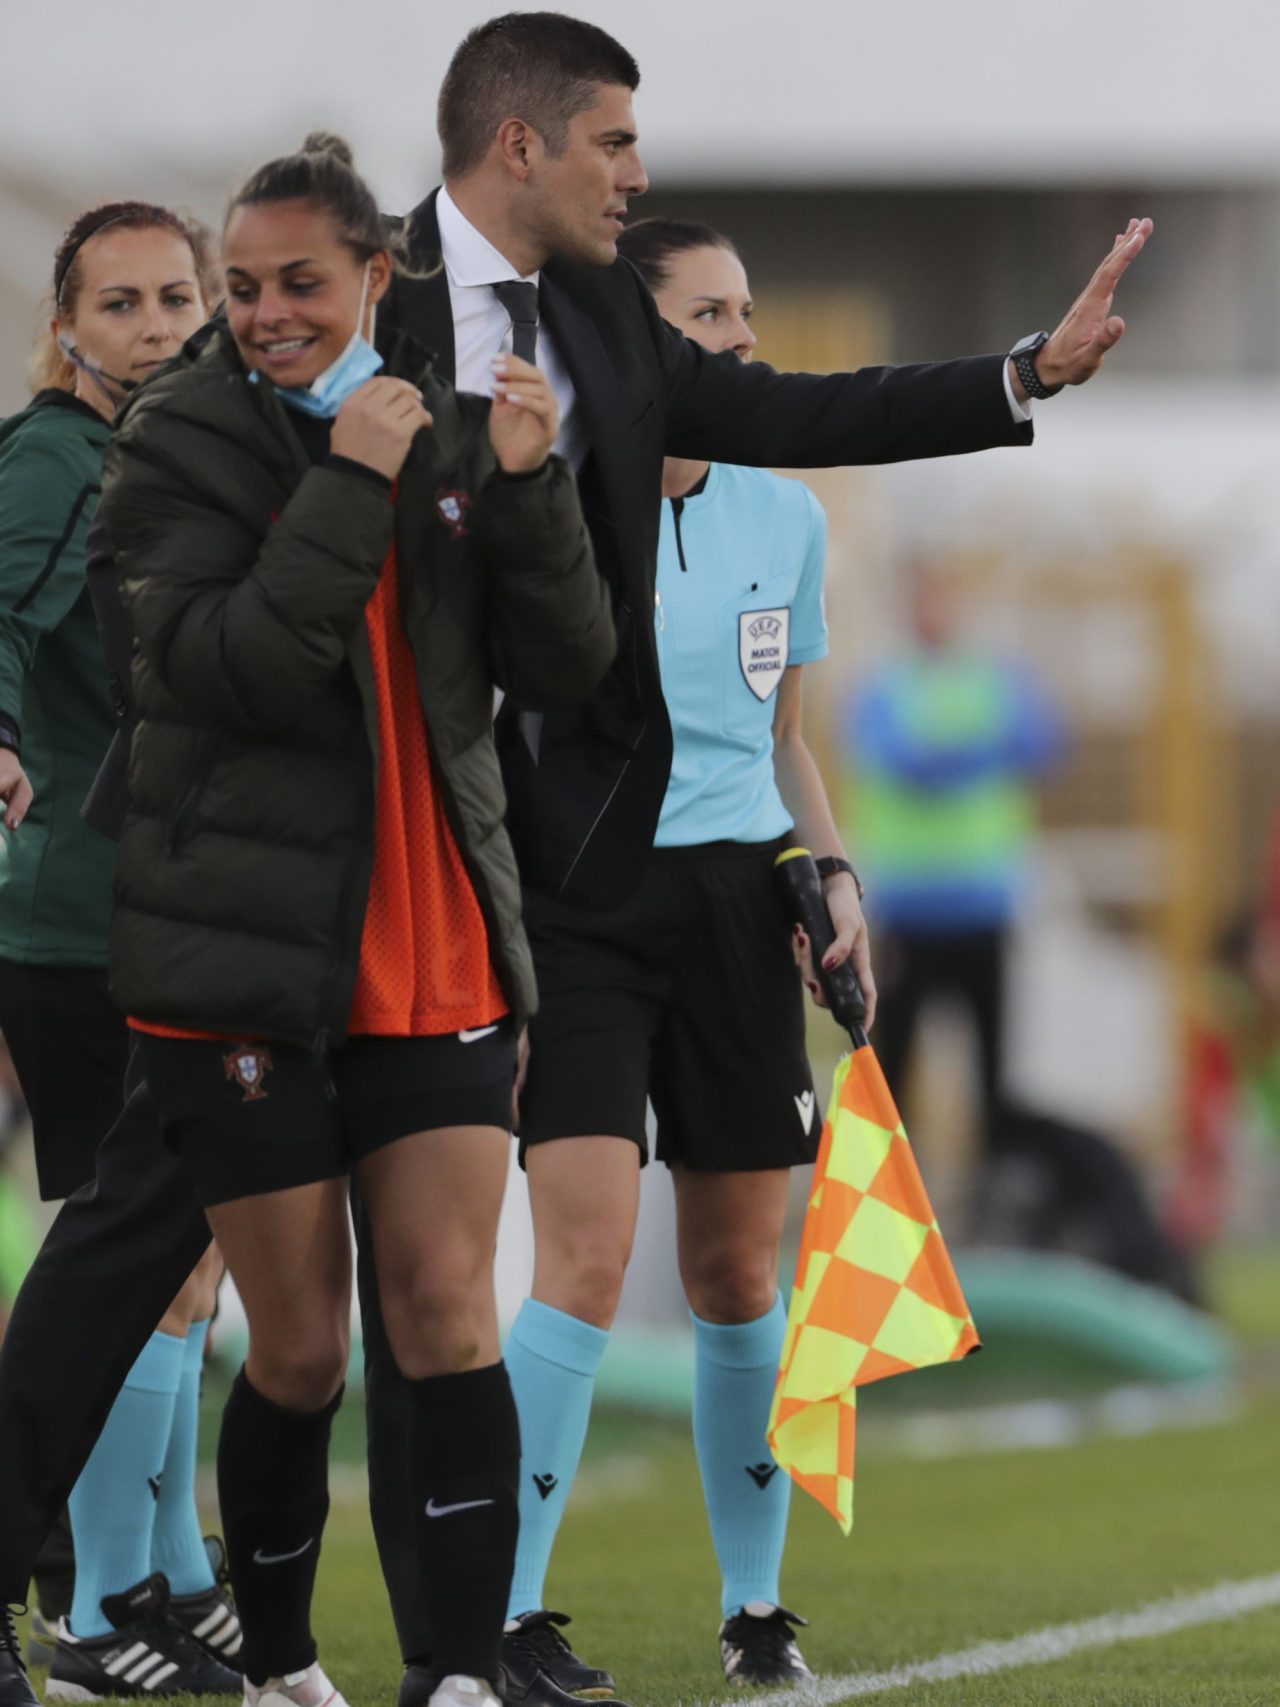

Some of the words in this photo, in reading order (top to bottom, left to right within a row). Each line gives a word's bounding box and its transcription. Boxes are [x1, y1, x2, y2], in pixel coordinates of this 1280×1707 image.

[750, 619, 779, 638] UEFA
[752, 647, 780, 659] MATCH
[748, 660, 782, 673] OFFICIAL
